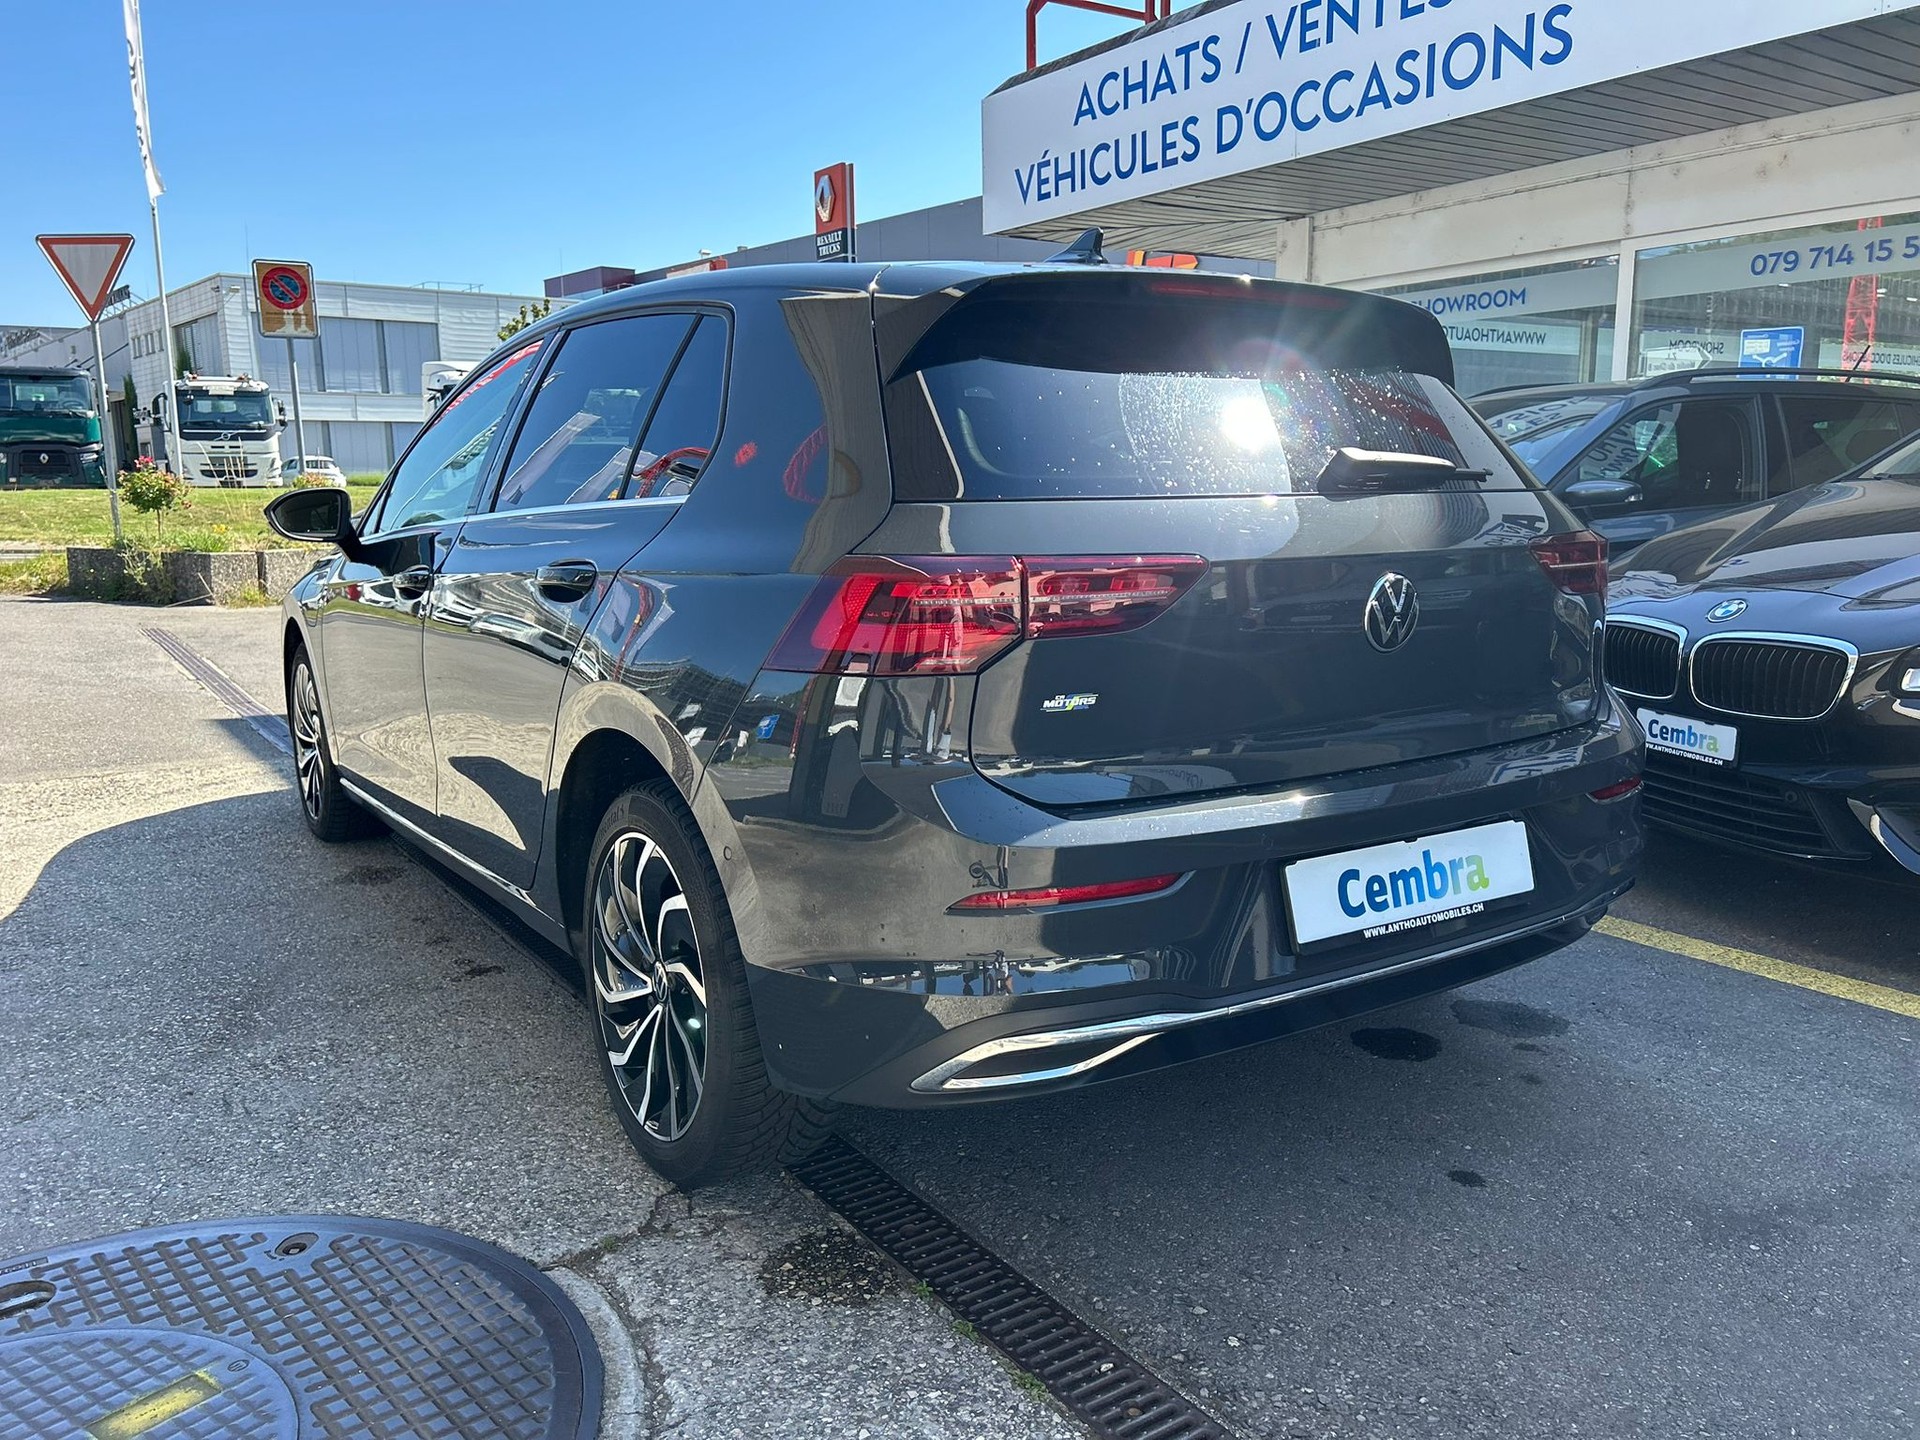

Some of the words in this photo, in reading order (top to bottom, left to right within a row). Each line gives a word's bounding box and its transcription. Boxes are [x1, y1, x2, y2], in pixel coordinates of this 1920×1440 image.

[1073, 34, 1222, 126] ACHATS
[1234, 21, 1253, 75] /
[1265, 0, 1453, 61] VEN
[1014, 115, 1201, 206] VÉHICULES
[1216, 3, 1574, 155] D'OCCASIONS
[816, 230, 843, 247] RENAULT
[818, 241, 841, 257] TRUCKS
[1750, 250, 1800, 276] 079
[1809, 243, 1855, 270] 714
[1865, 238, 1894, 263] 15
[1411, 286, 1527, 315] OWROOM
[1043, 696, 1097, 708] MOTORS
[1648, 718, 1720, 754] Cembra
[1337, 848, 1491, 919] Cembra
[1363, 902, 1485, 939] WWW.ANTHOAUTOMOBILES.CH
